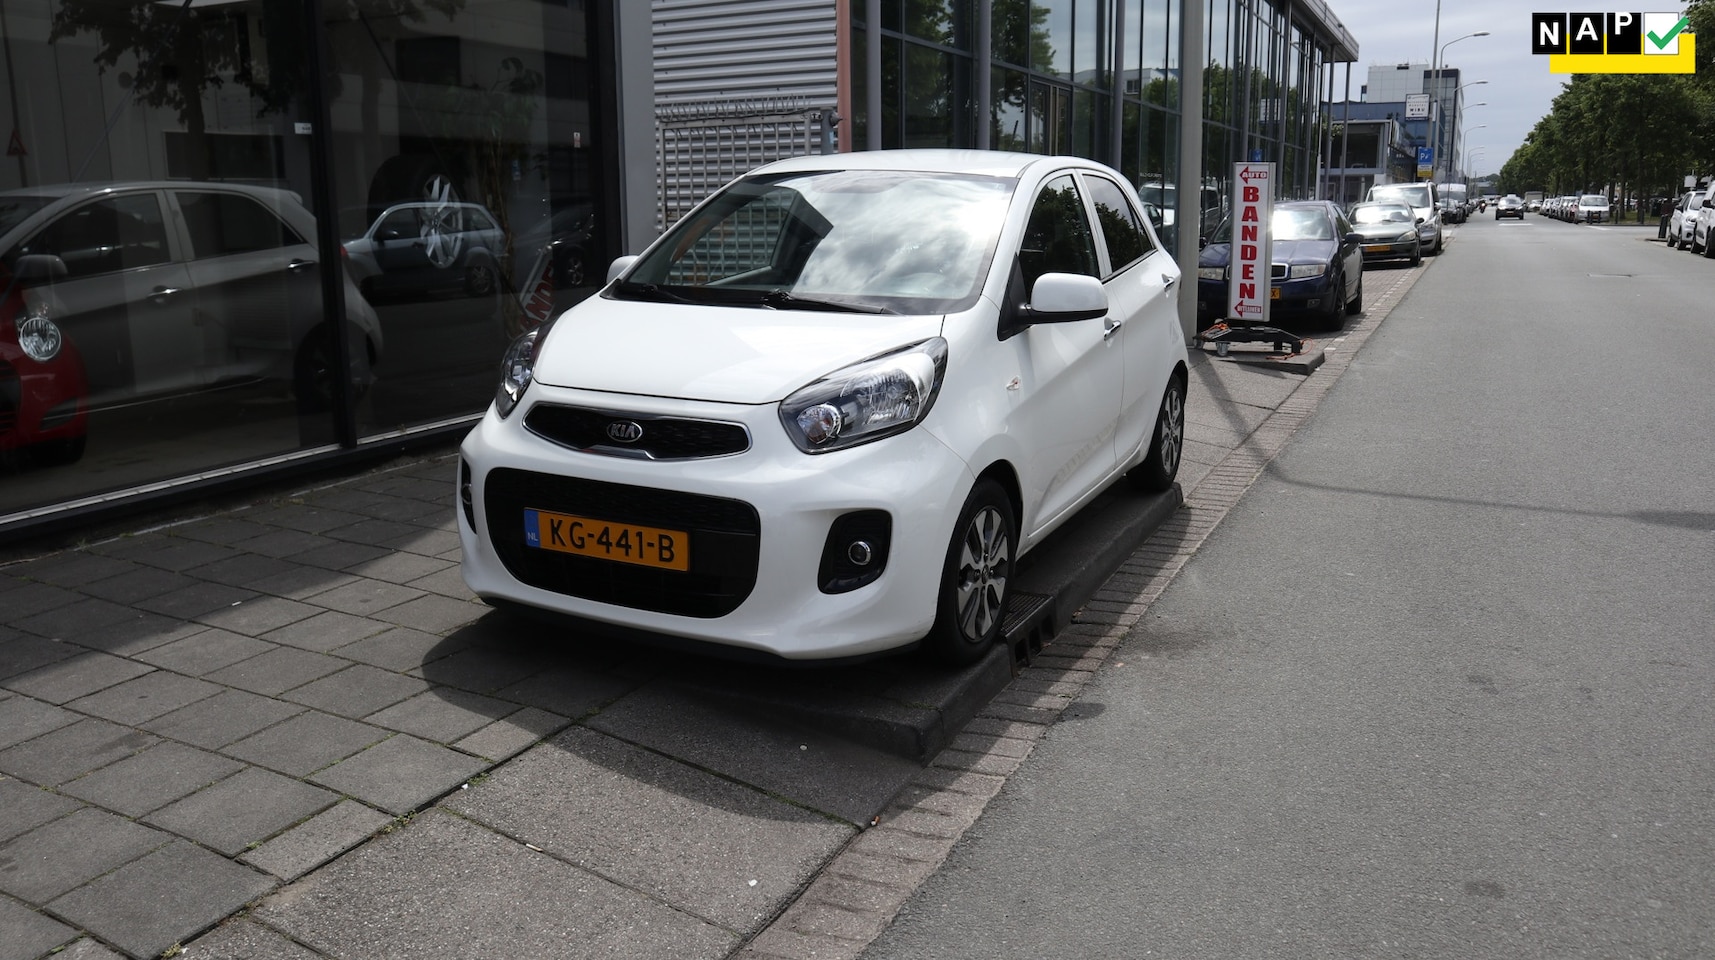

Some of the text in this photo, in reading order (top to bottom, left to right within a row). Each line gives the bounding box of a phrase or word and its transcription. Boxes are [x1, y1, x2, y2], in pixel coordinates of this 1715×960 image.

[1239, 186, 1260, 299] BANDEN
[610, 423, 636, 438] KIA
[527, 532, 539, 542] NL
[550, 518, 675, 562] KG-441-B
